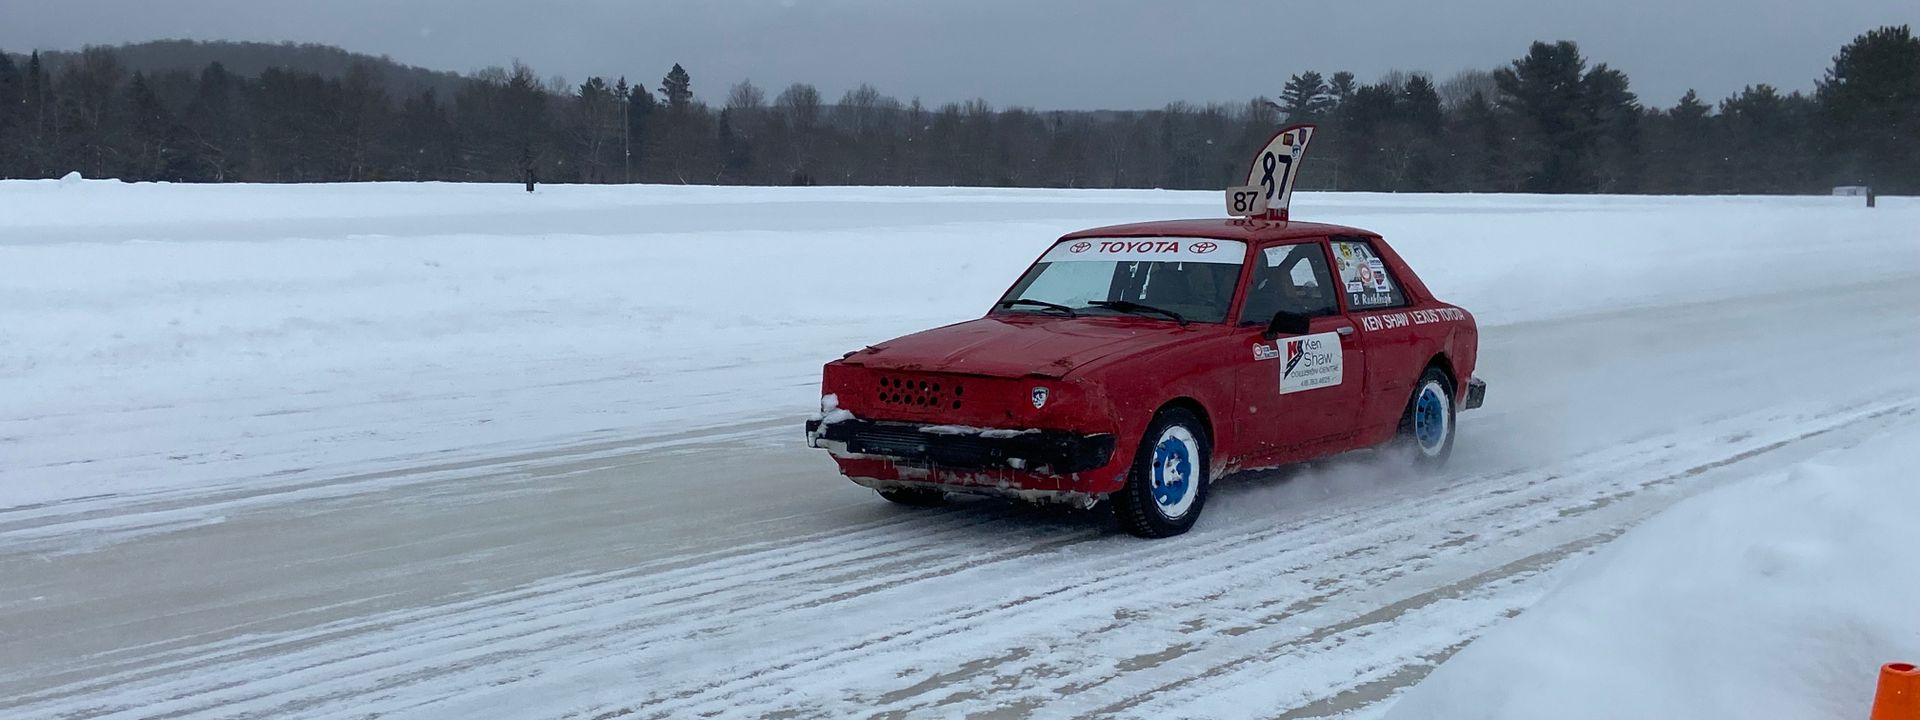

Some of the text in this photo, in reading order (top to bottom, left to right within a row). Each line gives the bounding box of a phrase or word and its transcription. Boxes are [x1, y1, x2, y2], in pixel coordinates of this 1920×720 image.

[1261, 151, 1292, 200] 87
[1234, 191, 1258, 212] 87
[1099, 241, 1179, 253] TOYOTA
[1361, 307, 1466, 332] KEN SHAW LEXUS TOYOTA
[1304, 339, 1322, 350] Ken
[1303, 351, 1333, 367] Shaw
[1290, 367, 1319, 379] COLLISION
